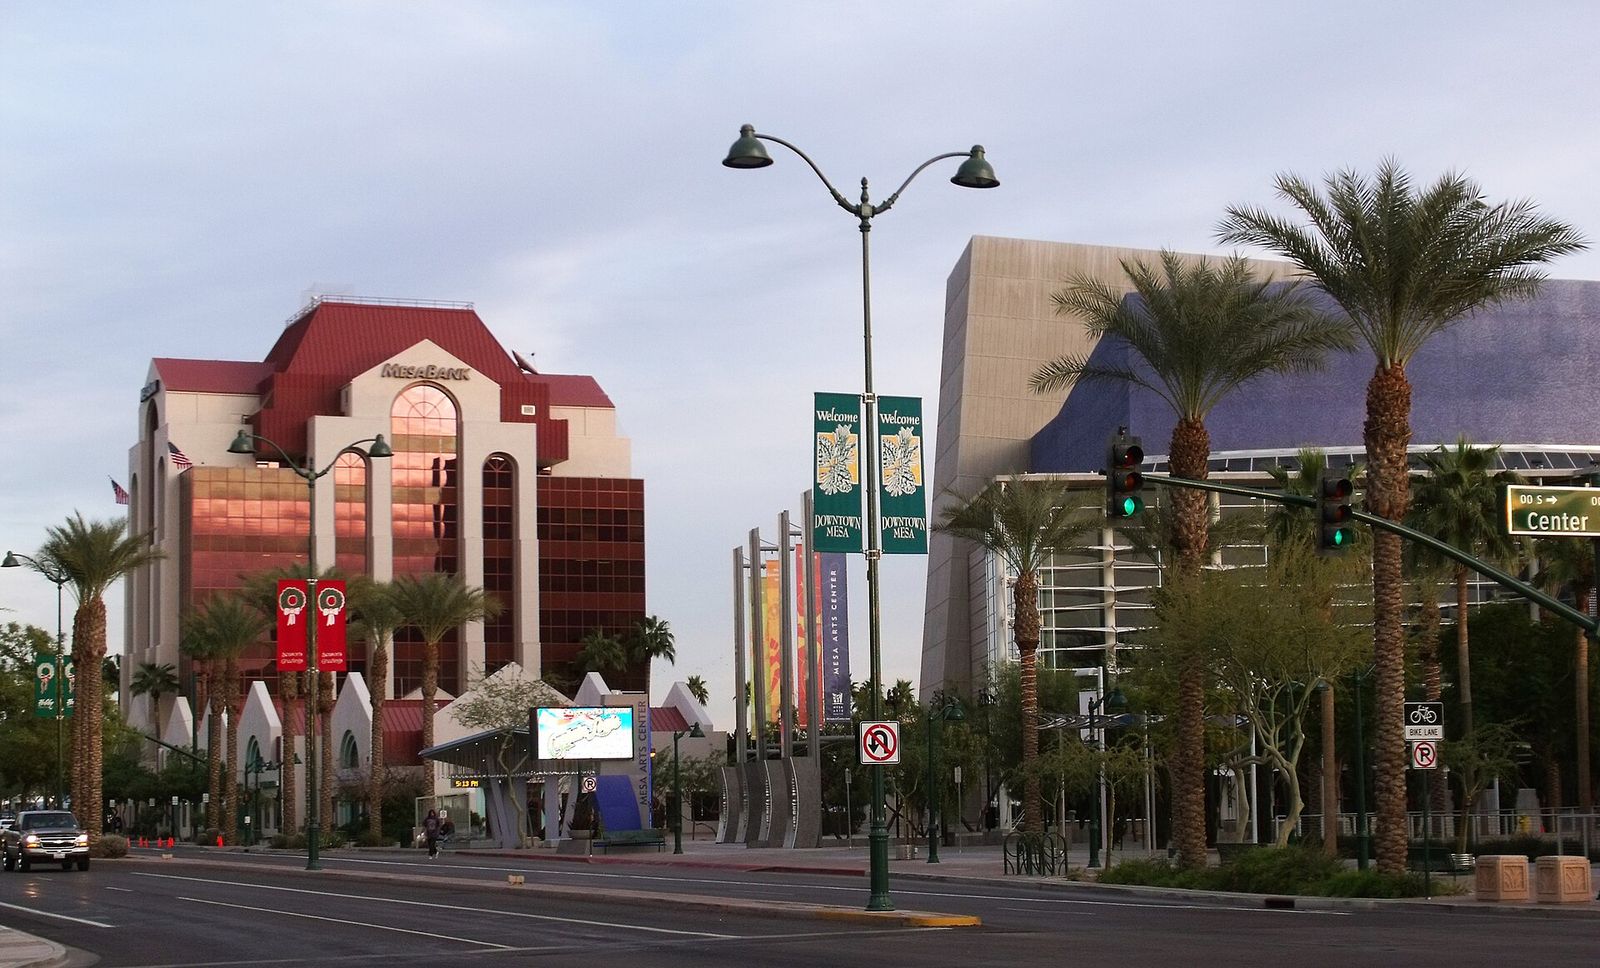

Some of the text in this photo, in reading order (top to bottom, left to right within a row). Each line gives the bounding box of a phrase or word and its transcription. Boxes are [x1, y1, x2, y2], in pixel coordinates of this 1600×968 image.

[816, 407, 859, 423] Welcome
[880, 410, 920, 425] Welcome
[1520, 494, 1543, 504] 00 S
[815, 514, 862, 530] DOWNTOWN
[882, 516, 926, 531] DOWNTOWN
[1527, 511, 1589, 531] Center
[826, 525, 850, 538] MESA
[893, 528, 915, 539] MESA
[832, 647, 840, 675] MESA
[1409, 728, 1438, 736] BIKE LANE
[638, 700, 648, 806] MESA ARTS CENTER
